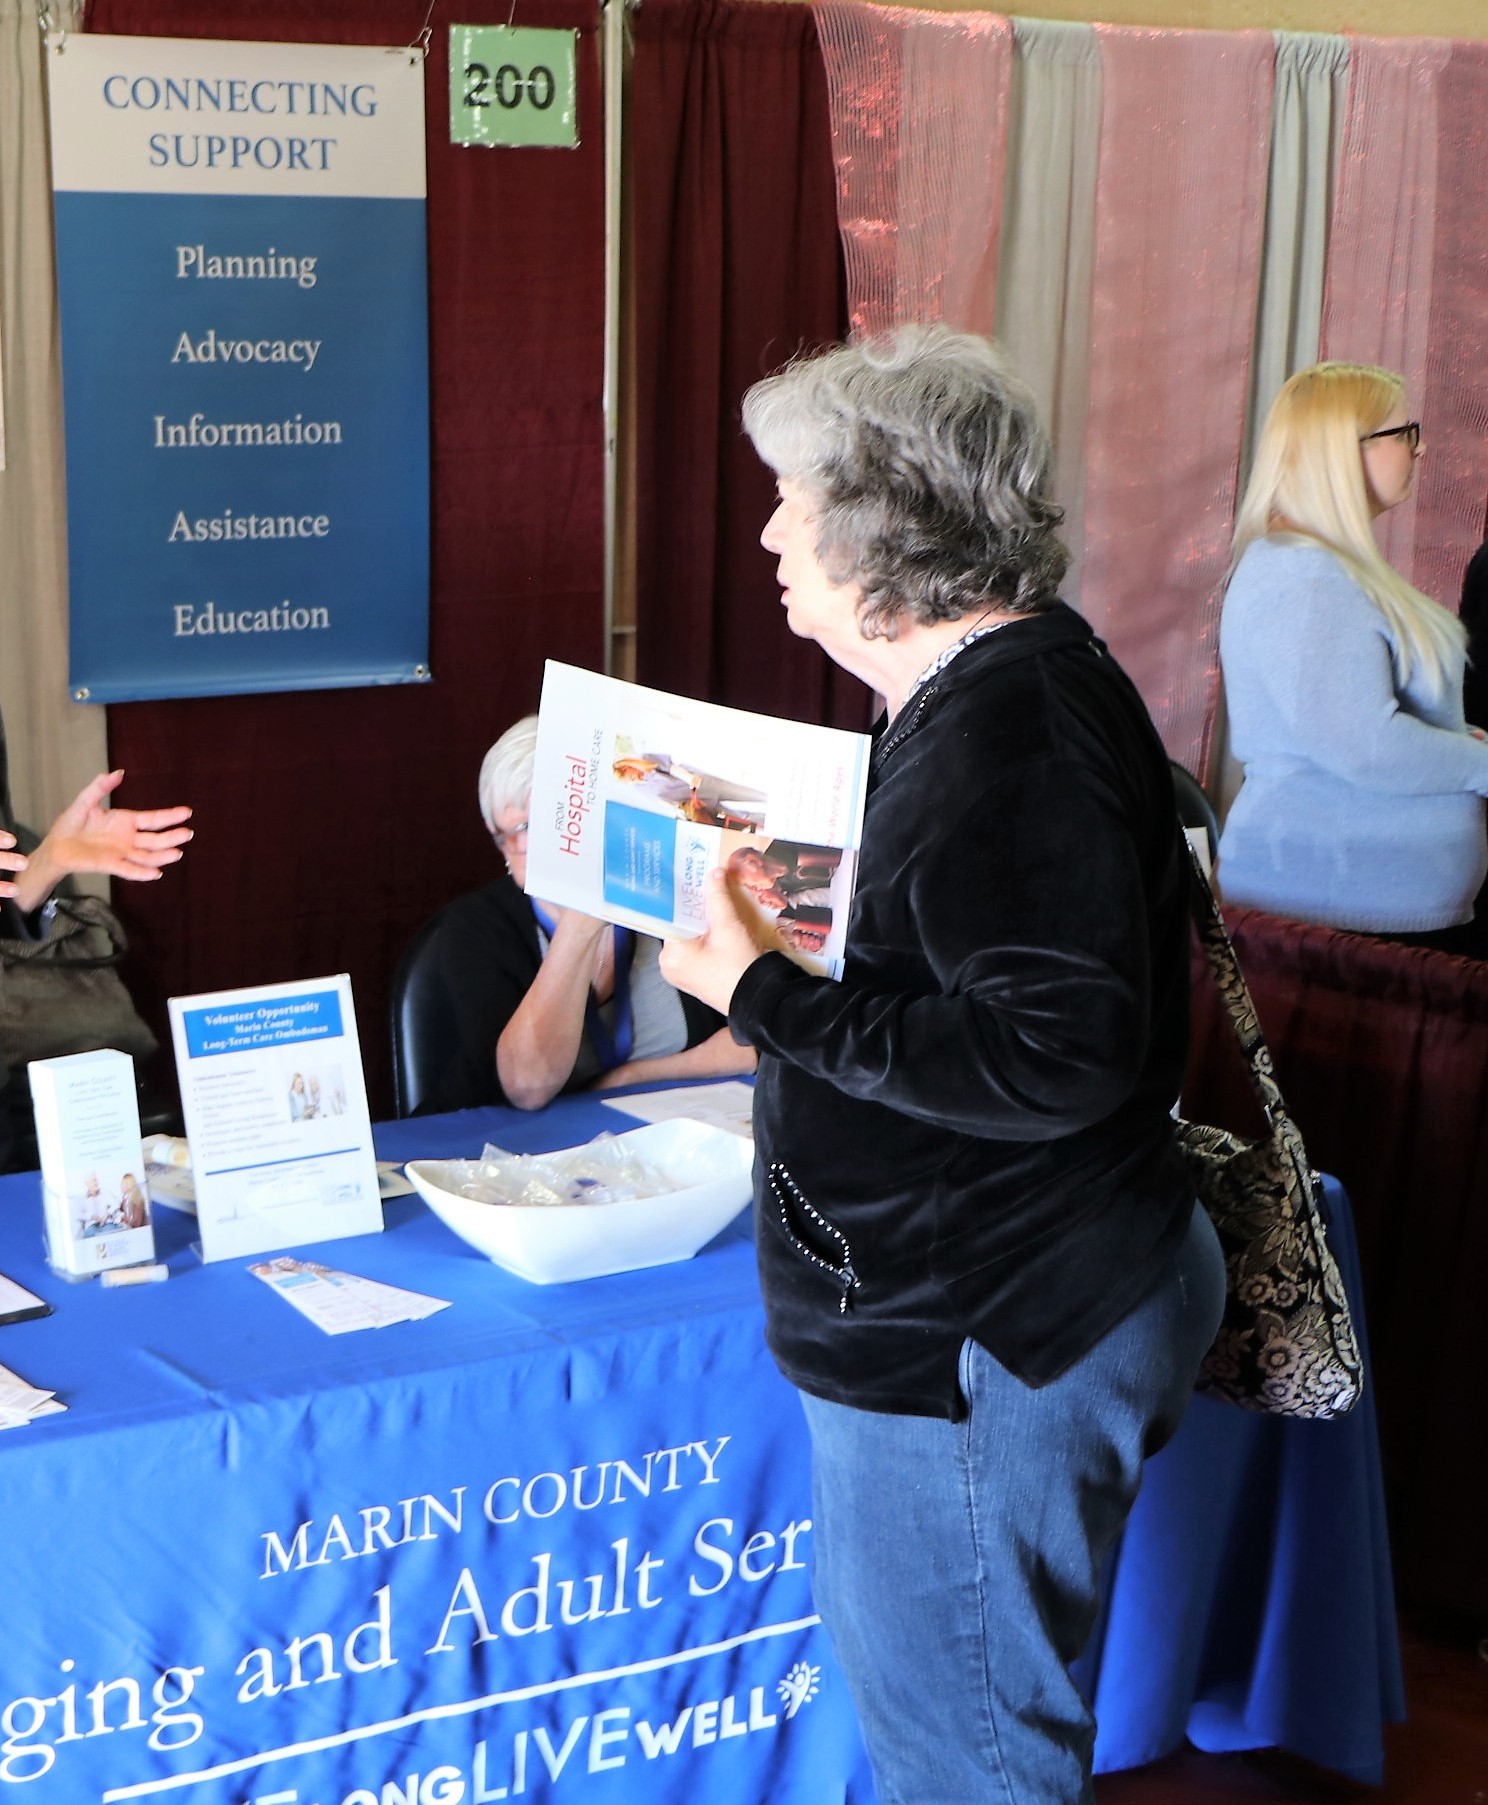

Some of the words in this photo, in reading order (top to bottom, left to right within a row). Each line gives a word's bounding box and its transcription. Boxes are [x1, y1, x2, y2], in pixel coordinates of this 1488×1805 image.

[102, 74, 378, 117] CONNECTING
[463, 63, 556, 110] 200
[149, 134, 337, 171] SUPPORT
[176, 245, 318, 287] Planning
[171, 331, 321, 371] Advocacy
[153, 413, 343, 448] Information
[167, 509, 330, 542] Assistance
[173, 600, 330, 637] Education
[592, 729, 602, 755] CARE
[588, 758, 600, 788] HOME
[560, 755, 588, 856] Hospital
[587, 791, 597, 805] TO
[555, 802, 564, 831] FROM
[696, 860, 704, 887] WELL
[205, 1011, 254, 1026] Volunteer
[257, 1001, 320, 1020] Opportunity
[234, 1022, 261, 1034] Marin
[263, 1018, 294, 1030] County
[202, 1034, 251, 1051] Long-Term
[275, 1024, 329, 1039] Ombudsman
[259, 1486, 465, 1580] MARIN
[483, 1434, 733, 1523] COUNTY
[236, 1588, 394, 1705] and
[425, 1536, 663, 1656] Adult
